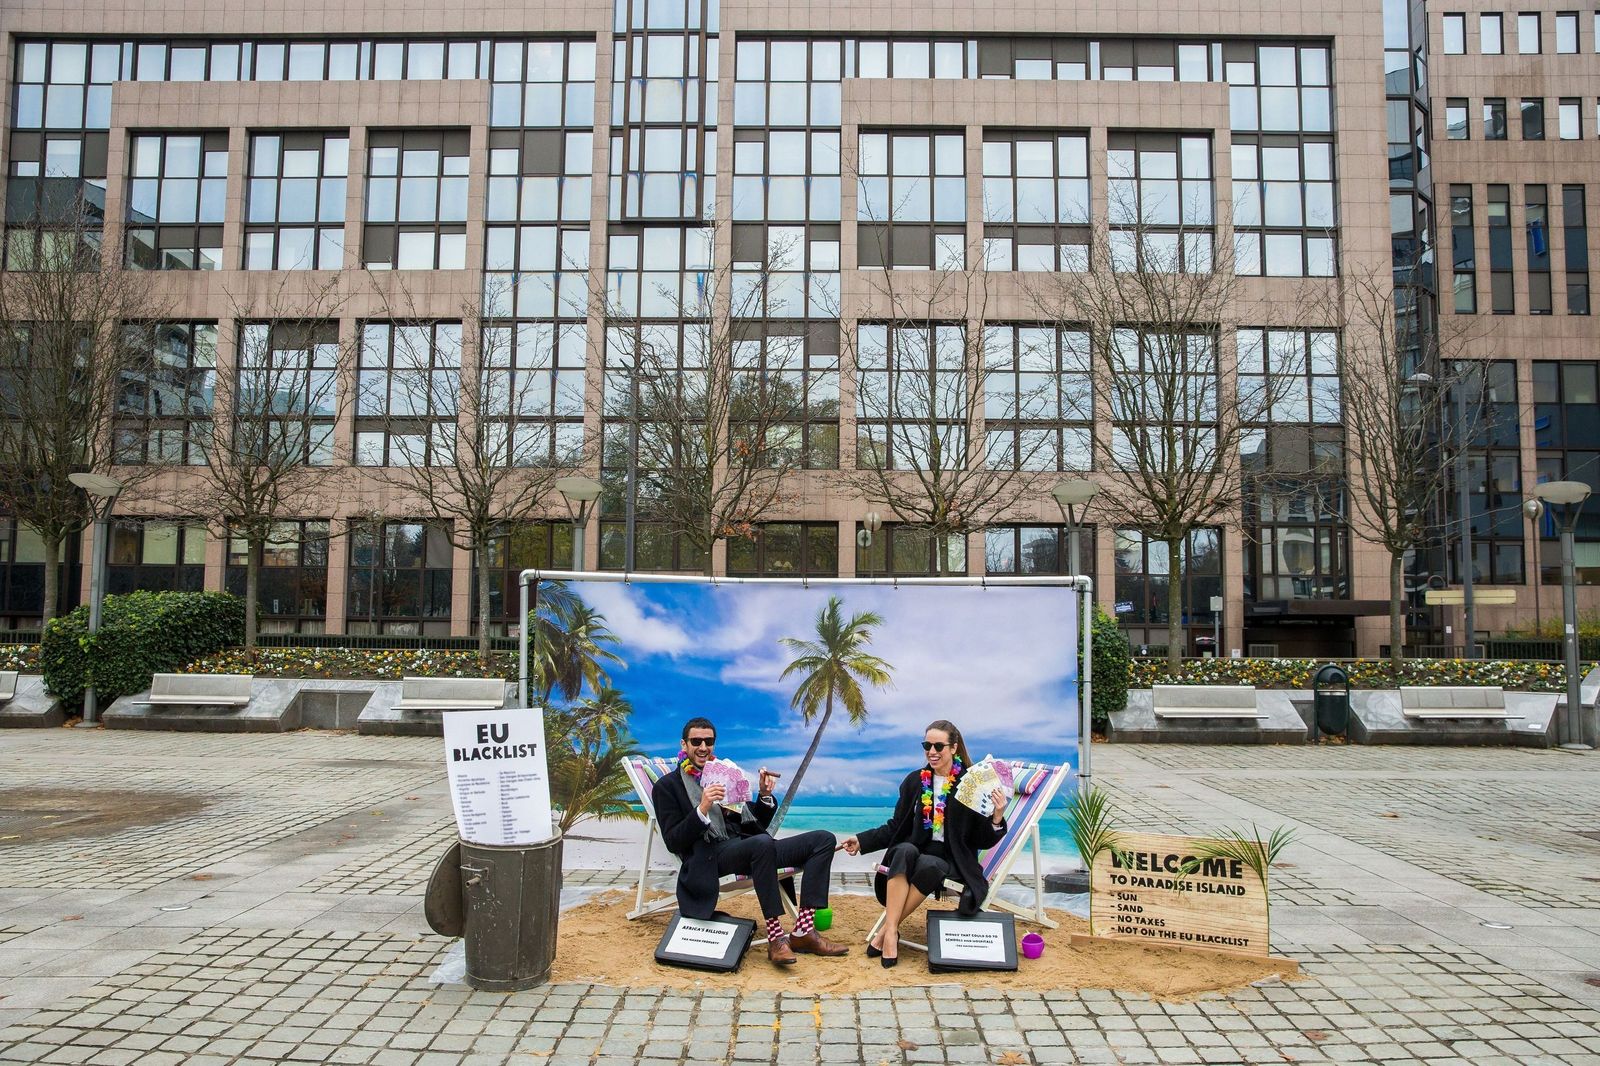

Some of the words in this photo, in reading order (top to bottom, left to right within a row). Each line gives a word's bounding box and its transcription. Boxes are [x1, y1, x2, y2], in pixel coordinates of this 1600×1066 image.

[476, 723, 509, 744] EU
[453, 743, 537, 762] BLACKLIST
[1110, 850, 1244, 879] WELCOME
[1110, 874, 1128, 885] TO
[1131, 876, 1193, 892] PARADISE
[1197, 882, 1246, 896] ISLAND
[1117, 892, 1138, 902] SUN
[1117, 903, 1144, 913] SAND
[1117, 915, 1133, 923] NO
[1135, 916, 1166, 927] TAXES
[705, 928, 729, 936] BILLIONS
[1117, 926, 1138, 935] NOT
[1140, 928, 1156, 937] ON
[1158, 930, 1177, 939] THE
[1179, 932, 1193, 941] EU
[1196, 934, 1250, 947] BLACKLIST
